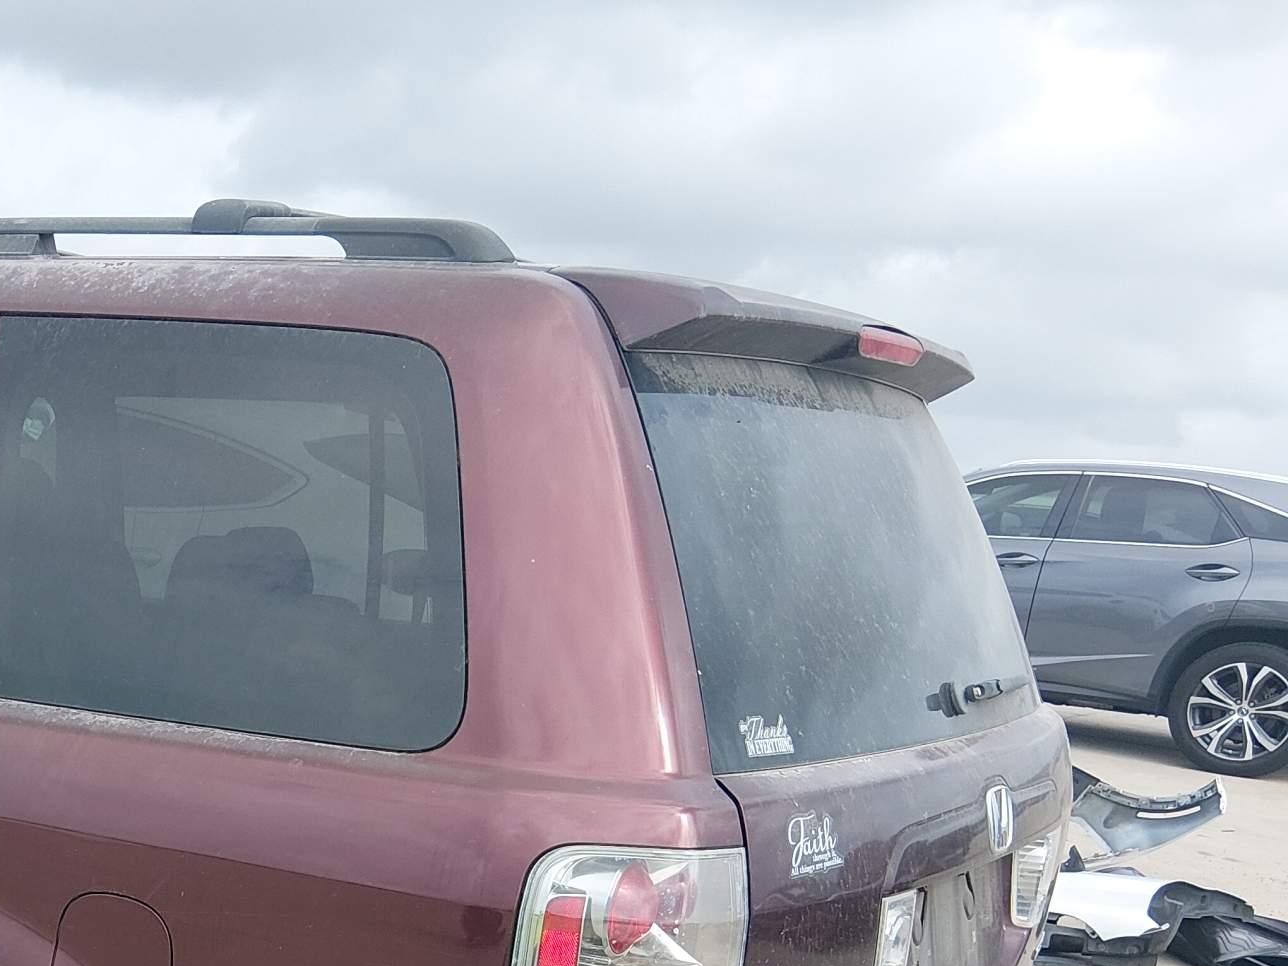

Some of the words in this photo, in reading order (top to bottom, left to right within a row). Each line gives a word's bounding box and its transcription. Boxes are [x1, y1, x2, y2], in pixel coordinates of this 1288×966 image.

[746, 714, 788, 740] Thanks
[788, 814, 837, 867] Faith
[791, 867, 799, 876] All
